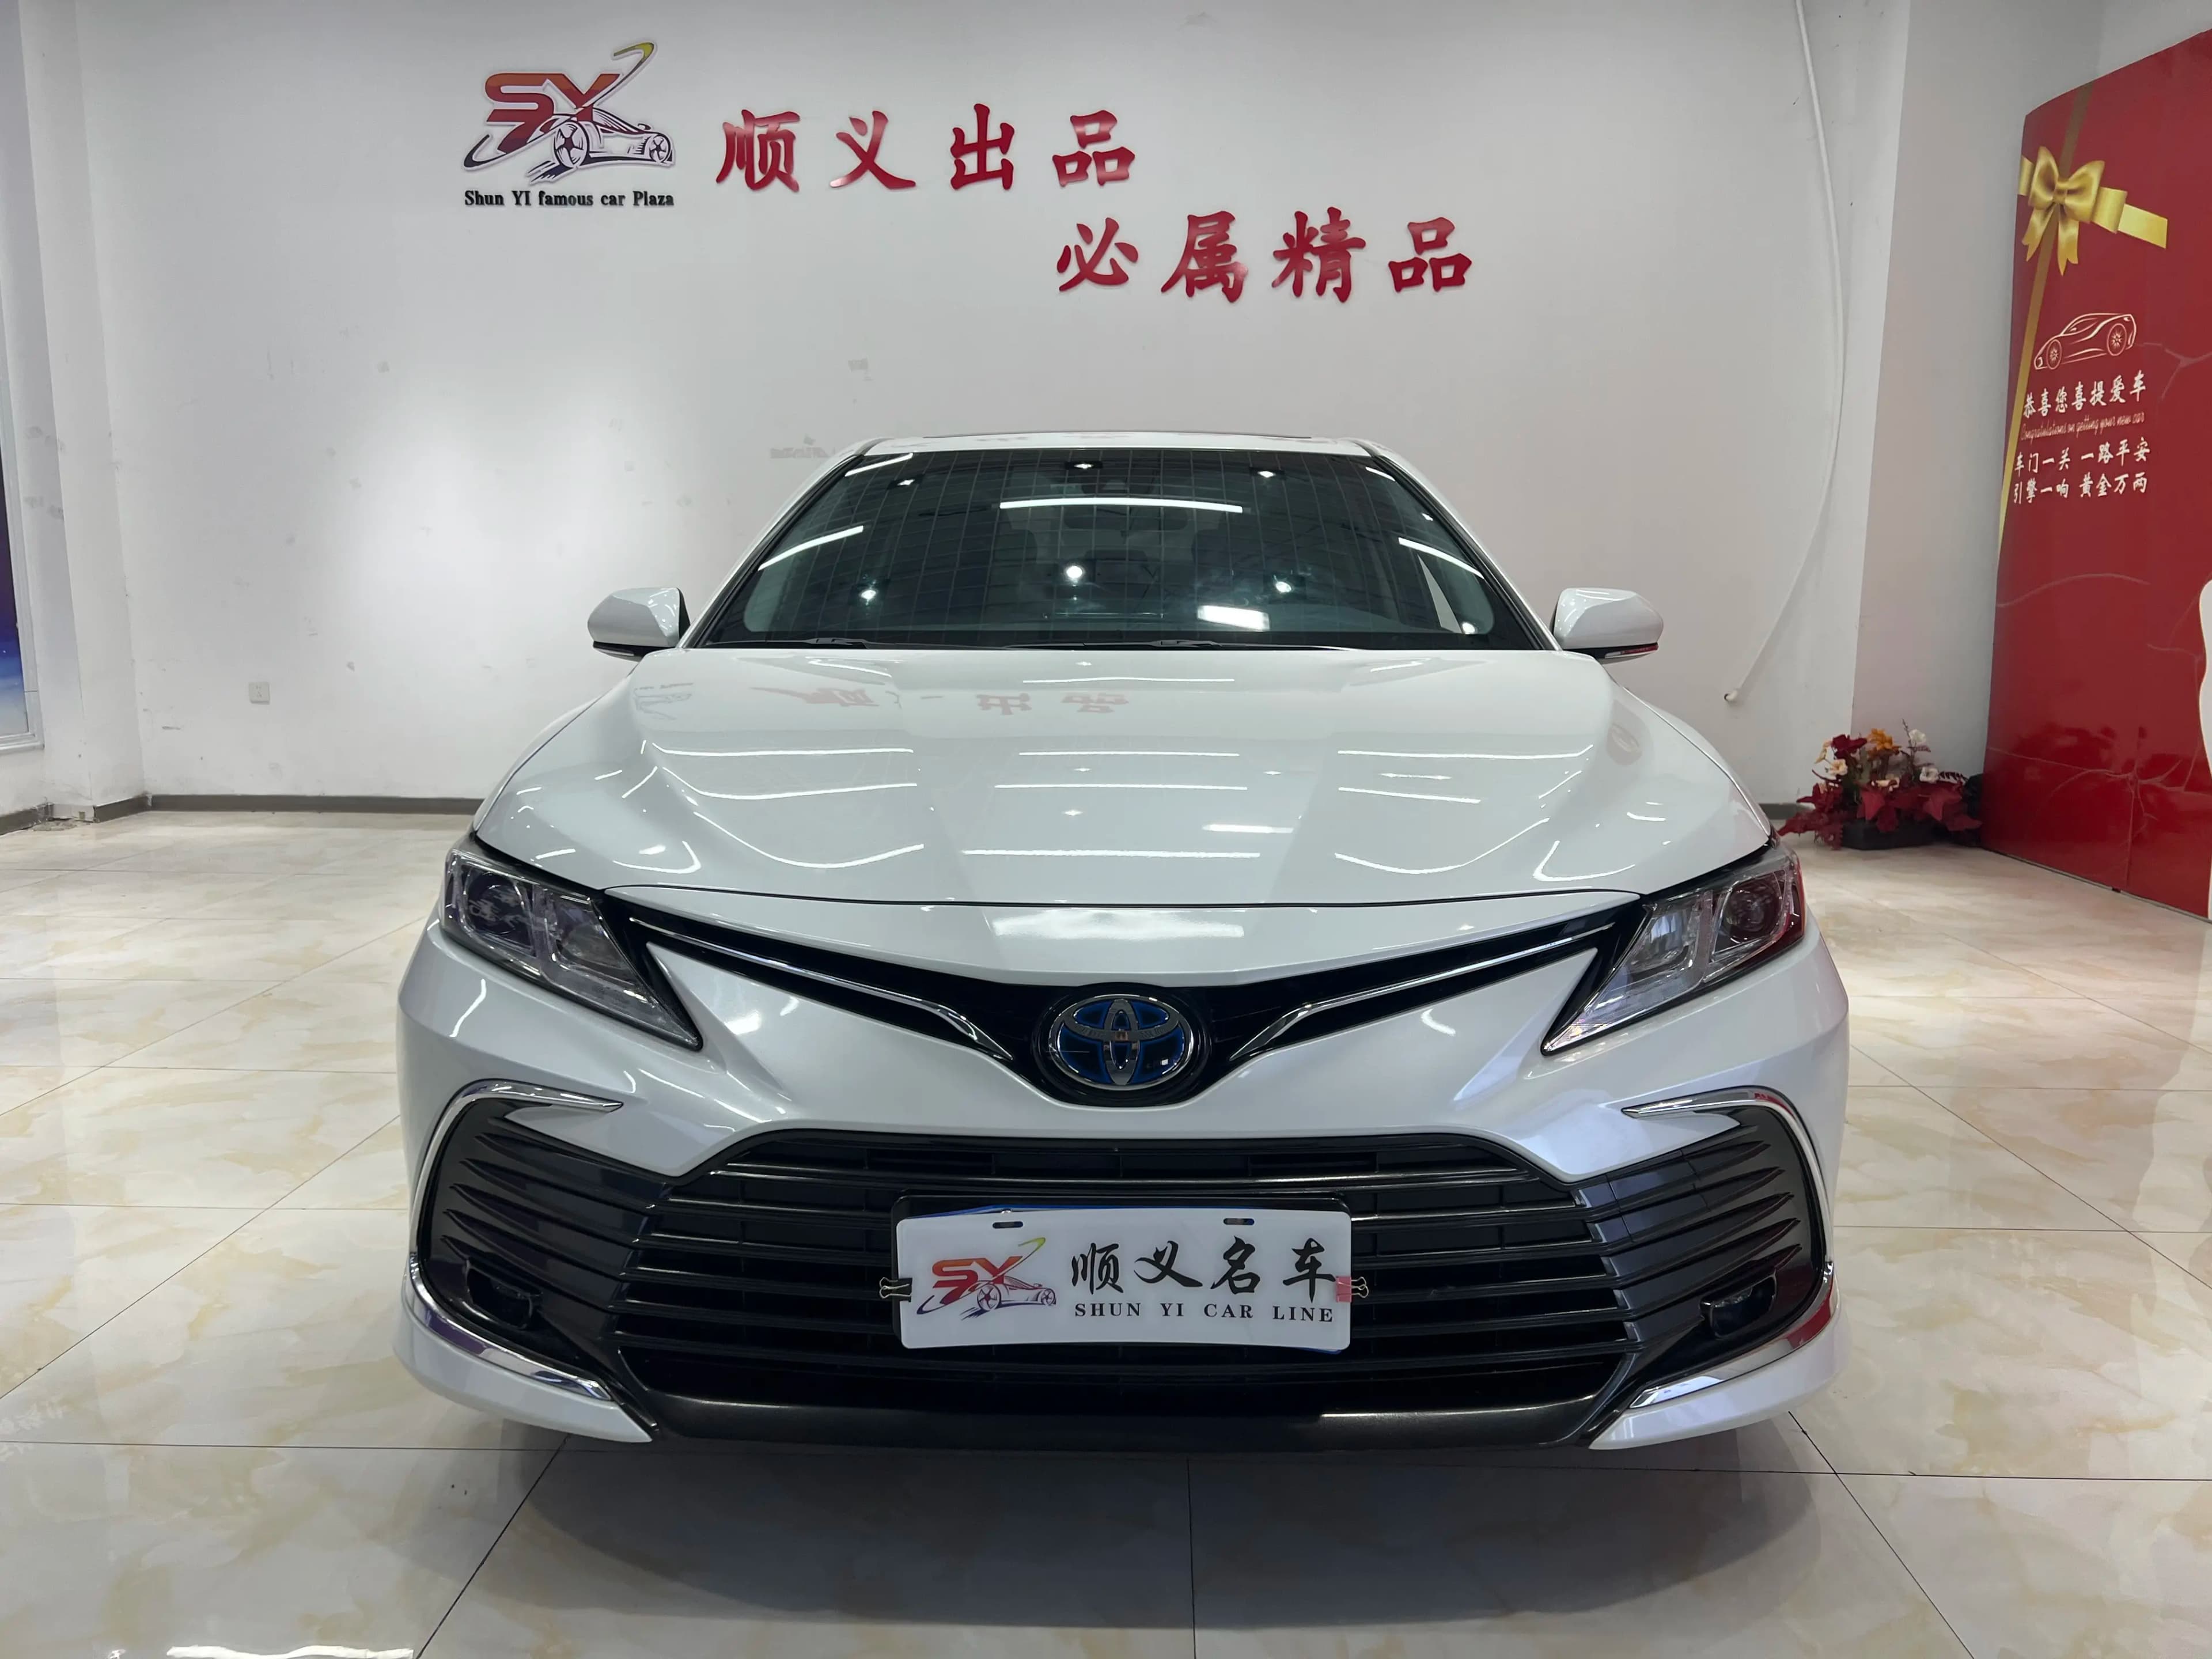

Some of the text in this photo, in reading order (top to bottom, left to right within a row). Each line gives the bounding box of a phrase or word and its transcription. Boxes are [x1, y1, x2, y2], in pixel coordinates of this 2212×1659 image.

[716, 103, 1135, 192] 顺义出品
[464, 191, 675, 206] Shun YI famous car Plaza
[1057, 207, 1473, 303] 必属精品
[2023, 370, 2146, 418] 恭喜您喜提爱车
[2014, 437, 2150, 477] 车门一关 一路平安
[2013, 472, 2147, 504] 引擎一响 黄金万两
[1071, 1236, 1336, 1303] 顺义名车
[1075, 1302, 1333, 1323] SHUN YI CAR LINE
